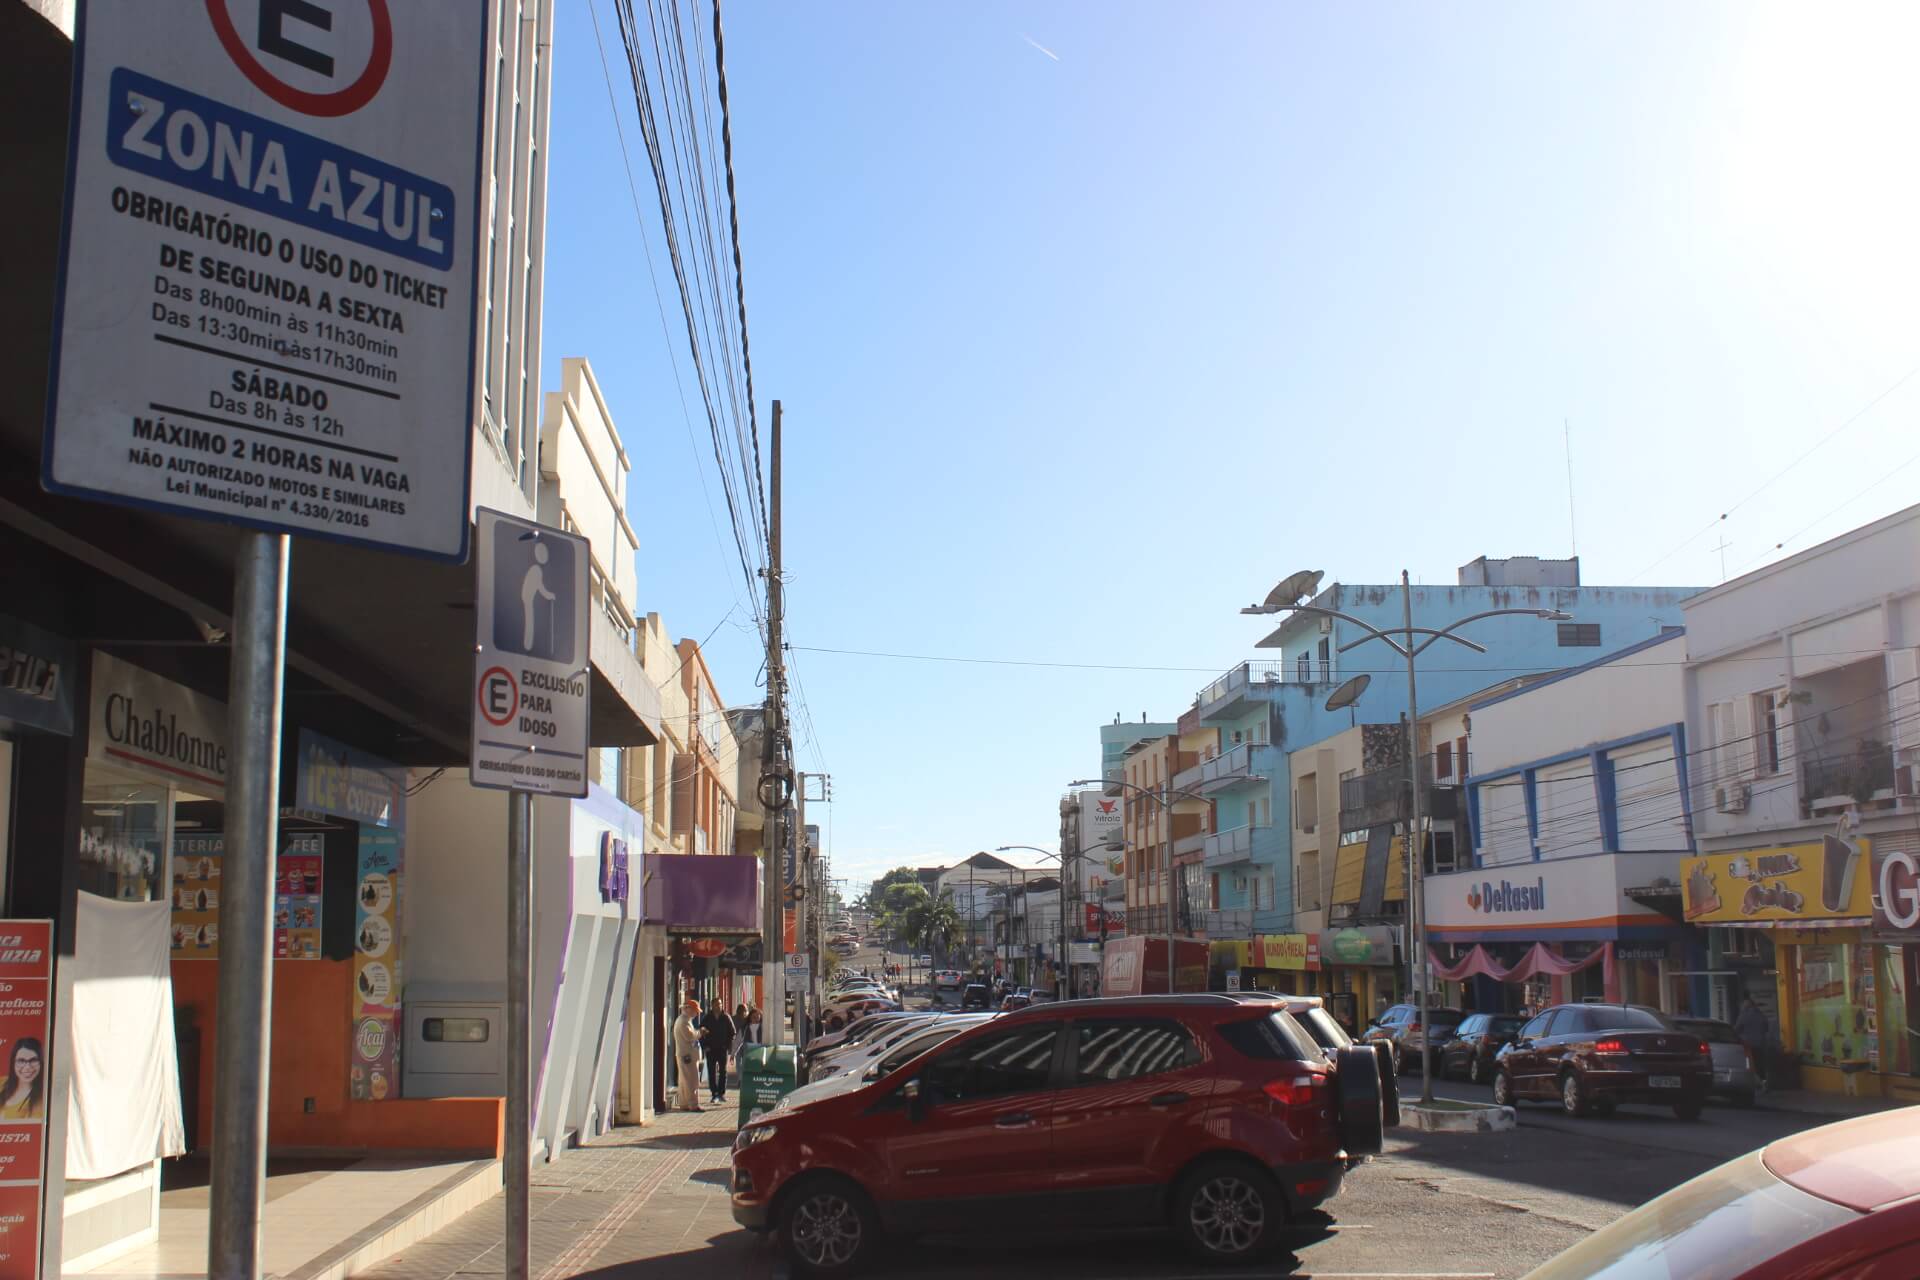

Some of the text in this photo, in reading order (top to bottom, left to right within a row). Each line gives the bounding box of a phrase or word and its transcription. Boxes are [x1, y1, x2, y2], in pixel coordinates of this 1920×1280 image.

[258, 0, 334, 78] E
[122, 90, 445, 254] ZONA AZUL
[111, 185, 448, 310] OBRIGATÓRIO O USO DO TICKET
[160, 244, 404, 334] DE SEGUNDA A SEXTA
[152, 302, 190, 329] Das
[198, 315, 288, 352] 13:30min
[154, 275, 398, 359] Das 8h00min às 11h30min
[210, 391, 344, 438] Das 8h às 12h
[231, 368, 328, 411] SÁBADO
[133, 416, 410, 493] MÁXIMO 2 HORAS NA VAGA
[129, 447, 406, 516] NÃO AUTORIZADO MOTOS E SIMILARES
[166, 477, 190, 494] Lei
[194, 482, 268, 511] Municipal
[290, 502, 369, 528] 4.330/2016
[489, 678, 508, 714] E
[520, 693, 553, 714] PARA
[521, 670, 584, 698] EXCLUSIVO
[519, 716, 556, 738] IDOSO
[1482, 876, 1545, 913] Deltasul
